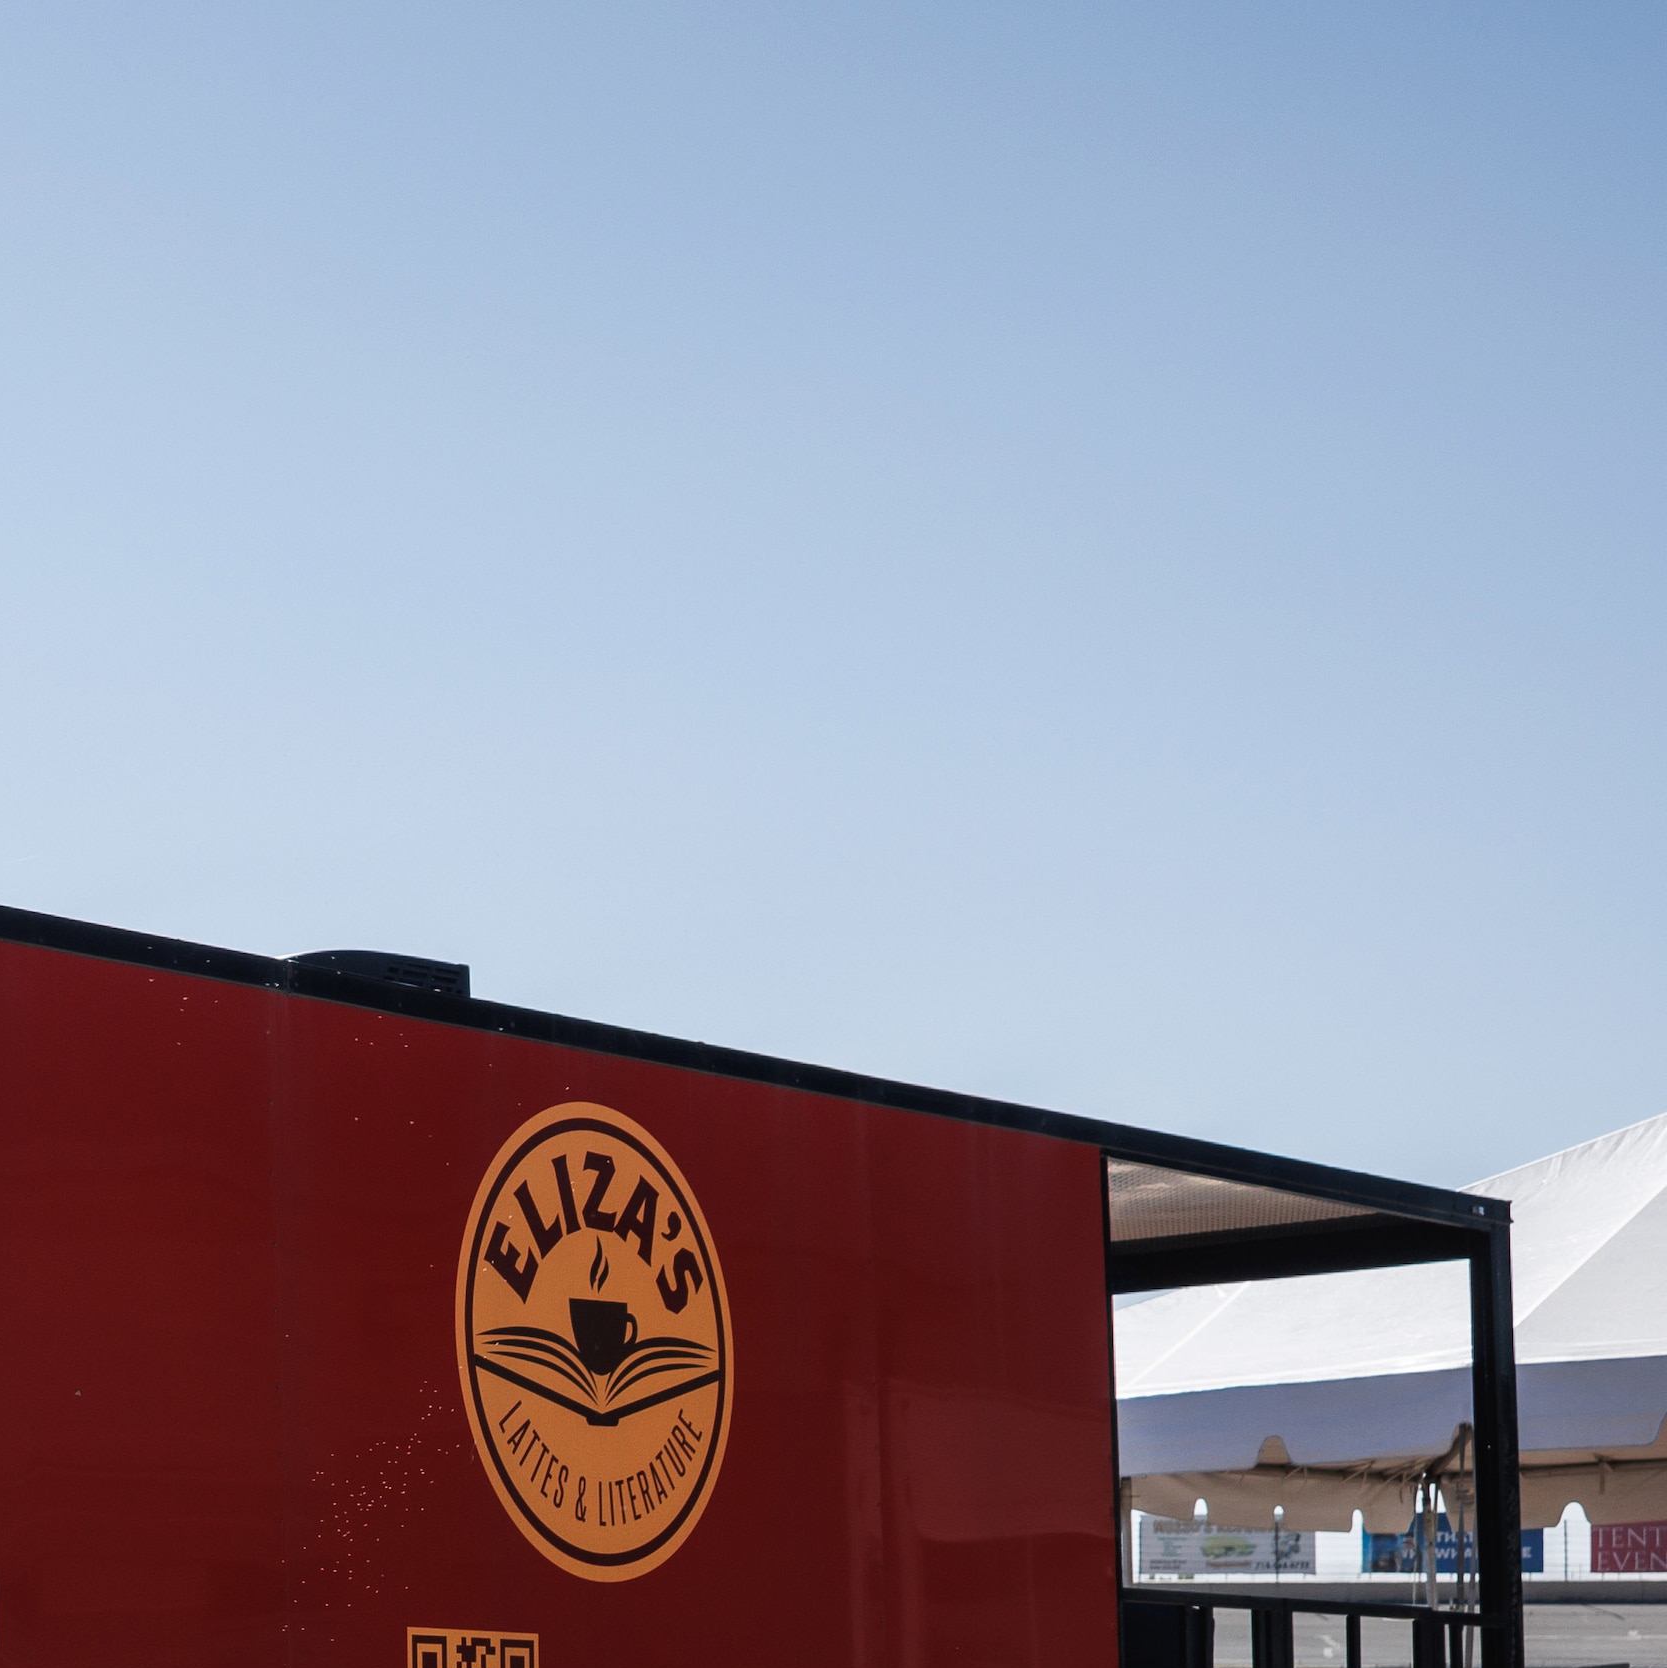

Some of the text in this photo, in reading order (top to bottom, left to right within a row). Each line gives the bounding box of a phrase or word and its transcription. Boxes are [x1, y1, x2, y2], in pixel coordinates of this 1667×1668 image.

[483, 1151, 704, 1315] ELIZA'S
[499, 1400, 703, 1527] LATTES & LITERATURE
